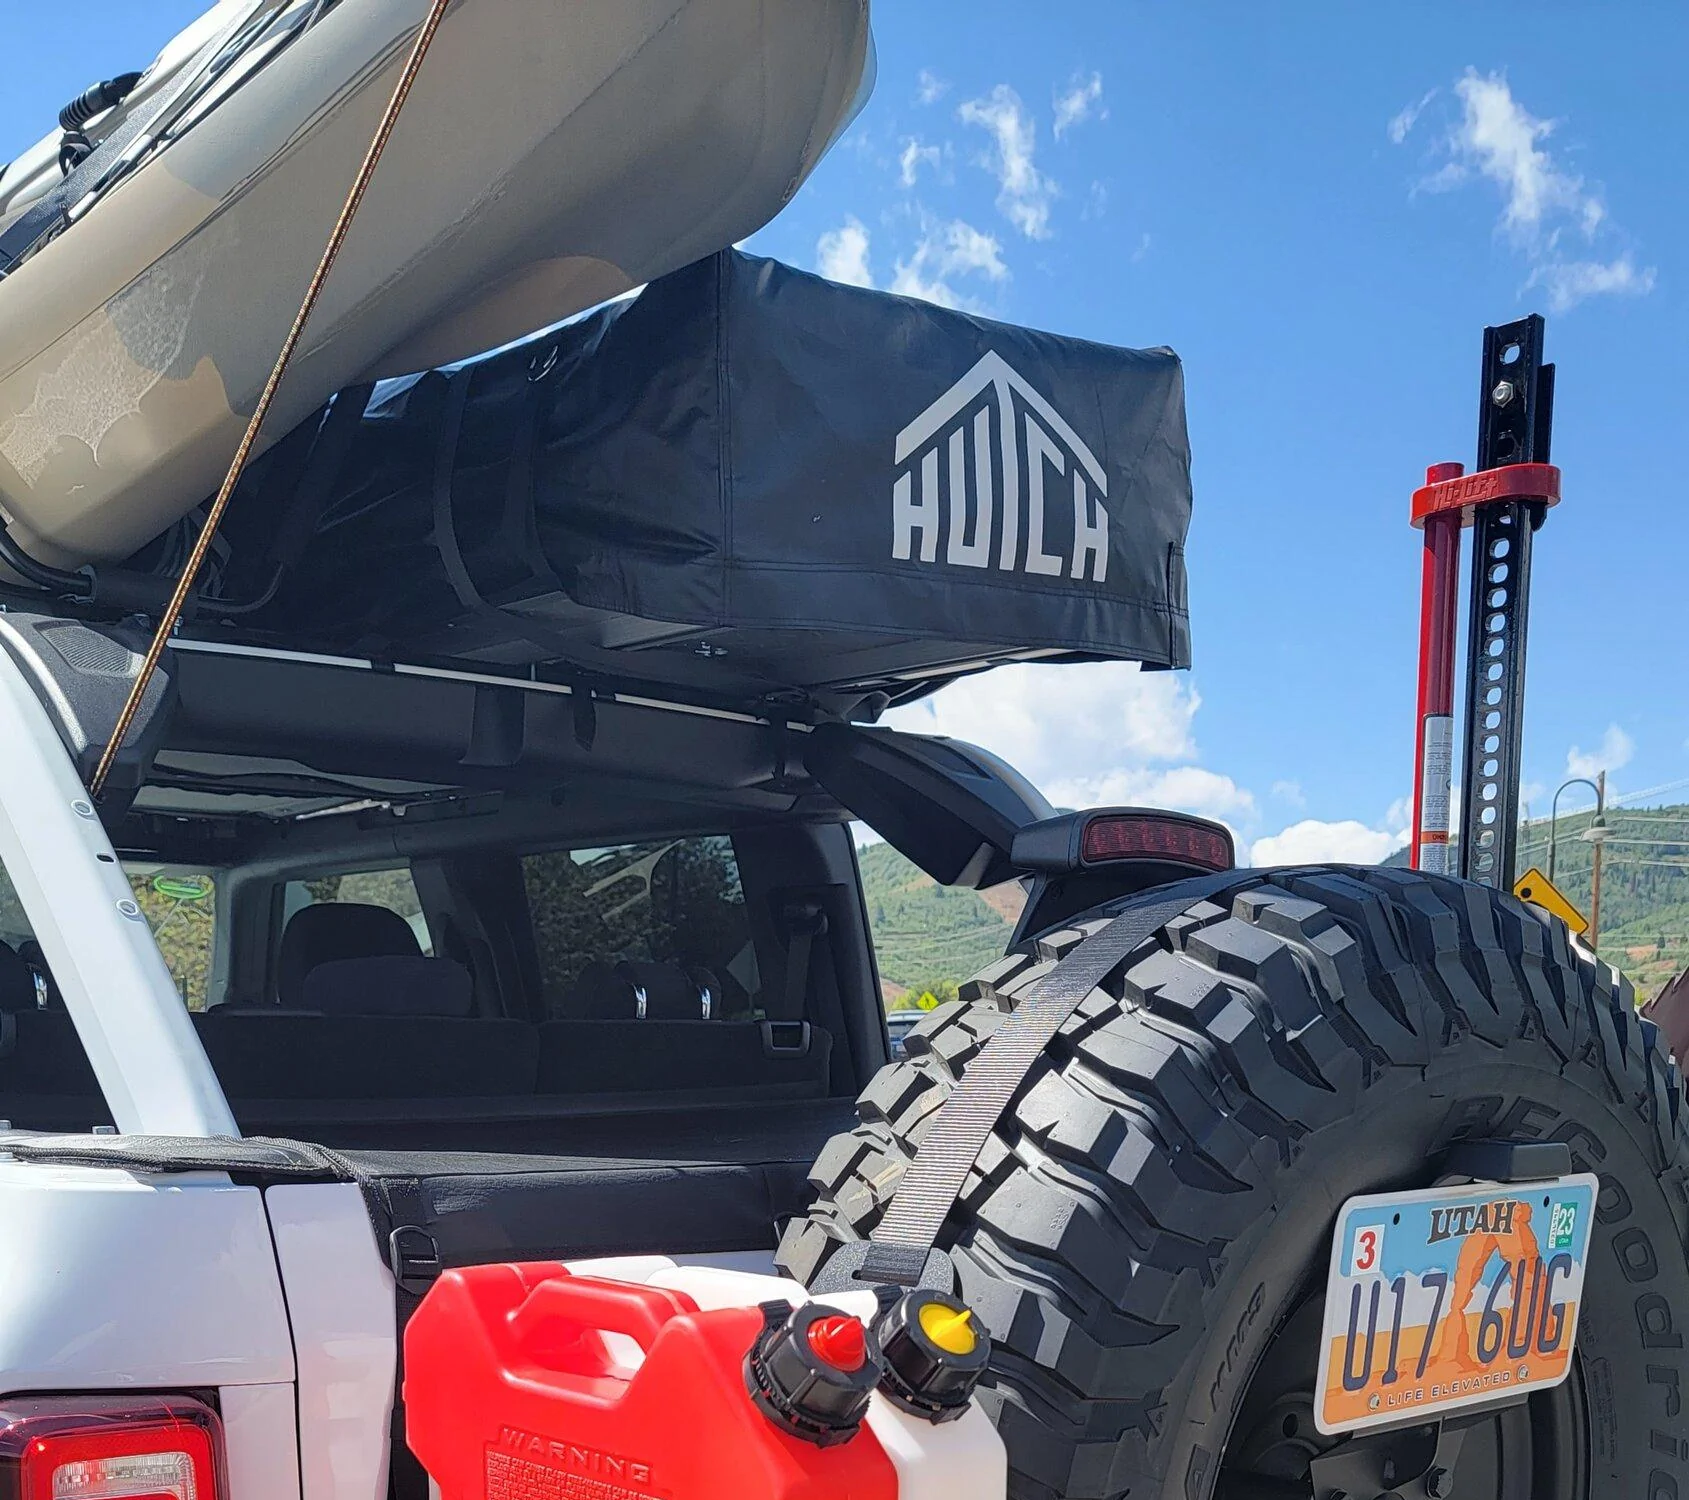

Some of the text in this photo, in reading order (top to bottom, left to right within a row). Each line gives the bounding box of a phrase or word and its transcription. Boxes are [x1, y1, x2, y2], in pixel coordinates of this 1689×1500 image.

[892, 349, 1109, 583] HUTCH
[1427, 1200, 1517, 1245] UTAH
[1558, 1207, 1577, 1236] 23
[1356, 1230, 1377, 1270] 3
[1342, 1271, 1448, 1392] U17
[1476, 1253, 1572, 1364] 6UG
[1388, 1372, 1511, 1406] LIFE ELEVATED
[503, 1427, 650, 1484] WARNING
